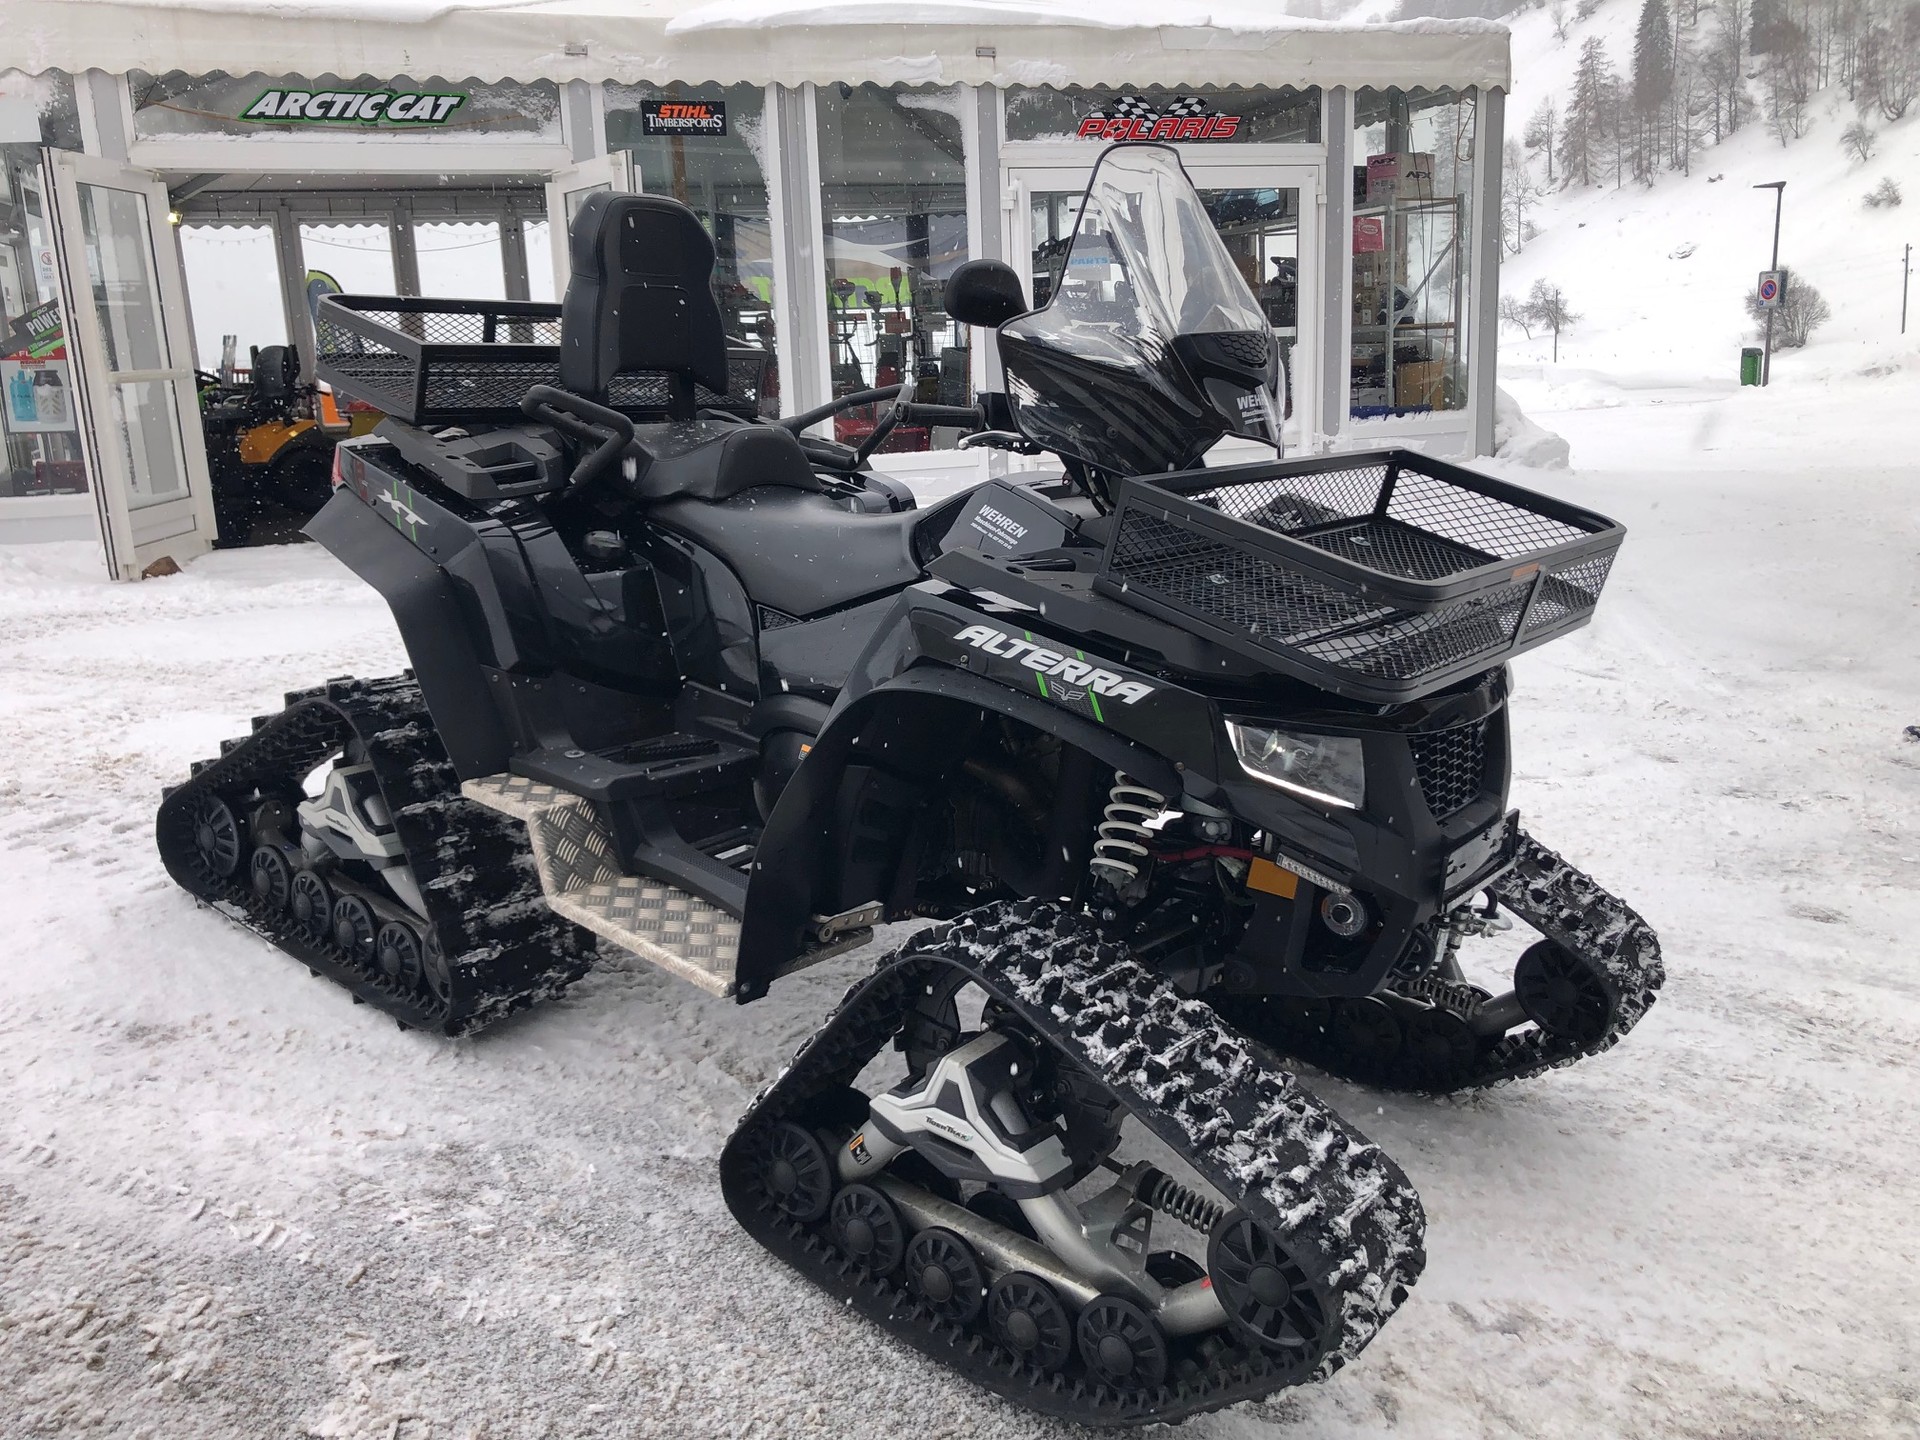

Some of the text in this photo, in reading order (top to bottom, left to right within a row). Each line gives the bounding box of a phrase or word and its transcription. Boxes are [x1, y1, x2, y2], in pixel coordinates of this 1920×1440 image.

[247, 91, 461, 120] ARCTIC CAT
[658, 104, 711, 118] STIHL
[1076, 116, 1242, 140] POLARIS
[377, 489, 429, 525] XT
[978, 504, 1028, 538] WEHREN
[953, 625, 1156, 705] ALTERRA
